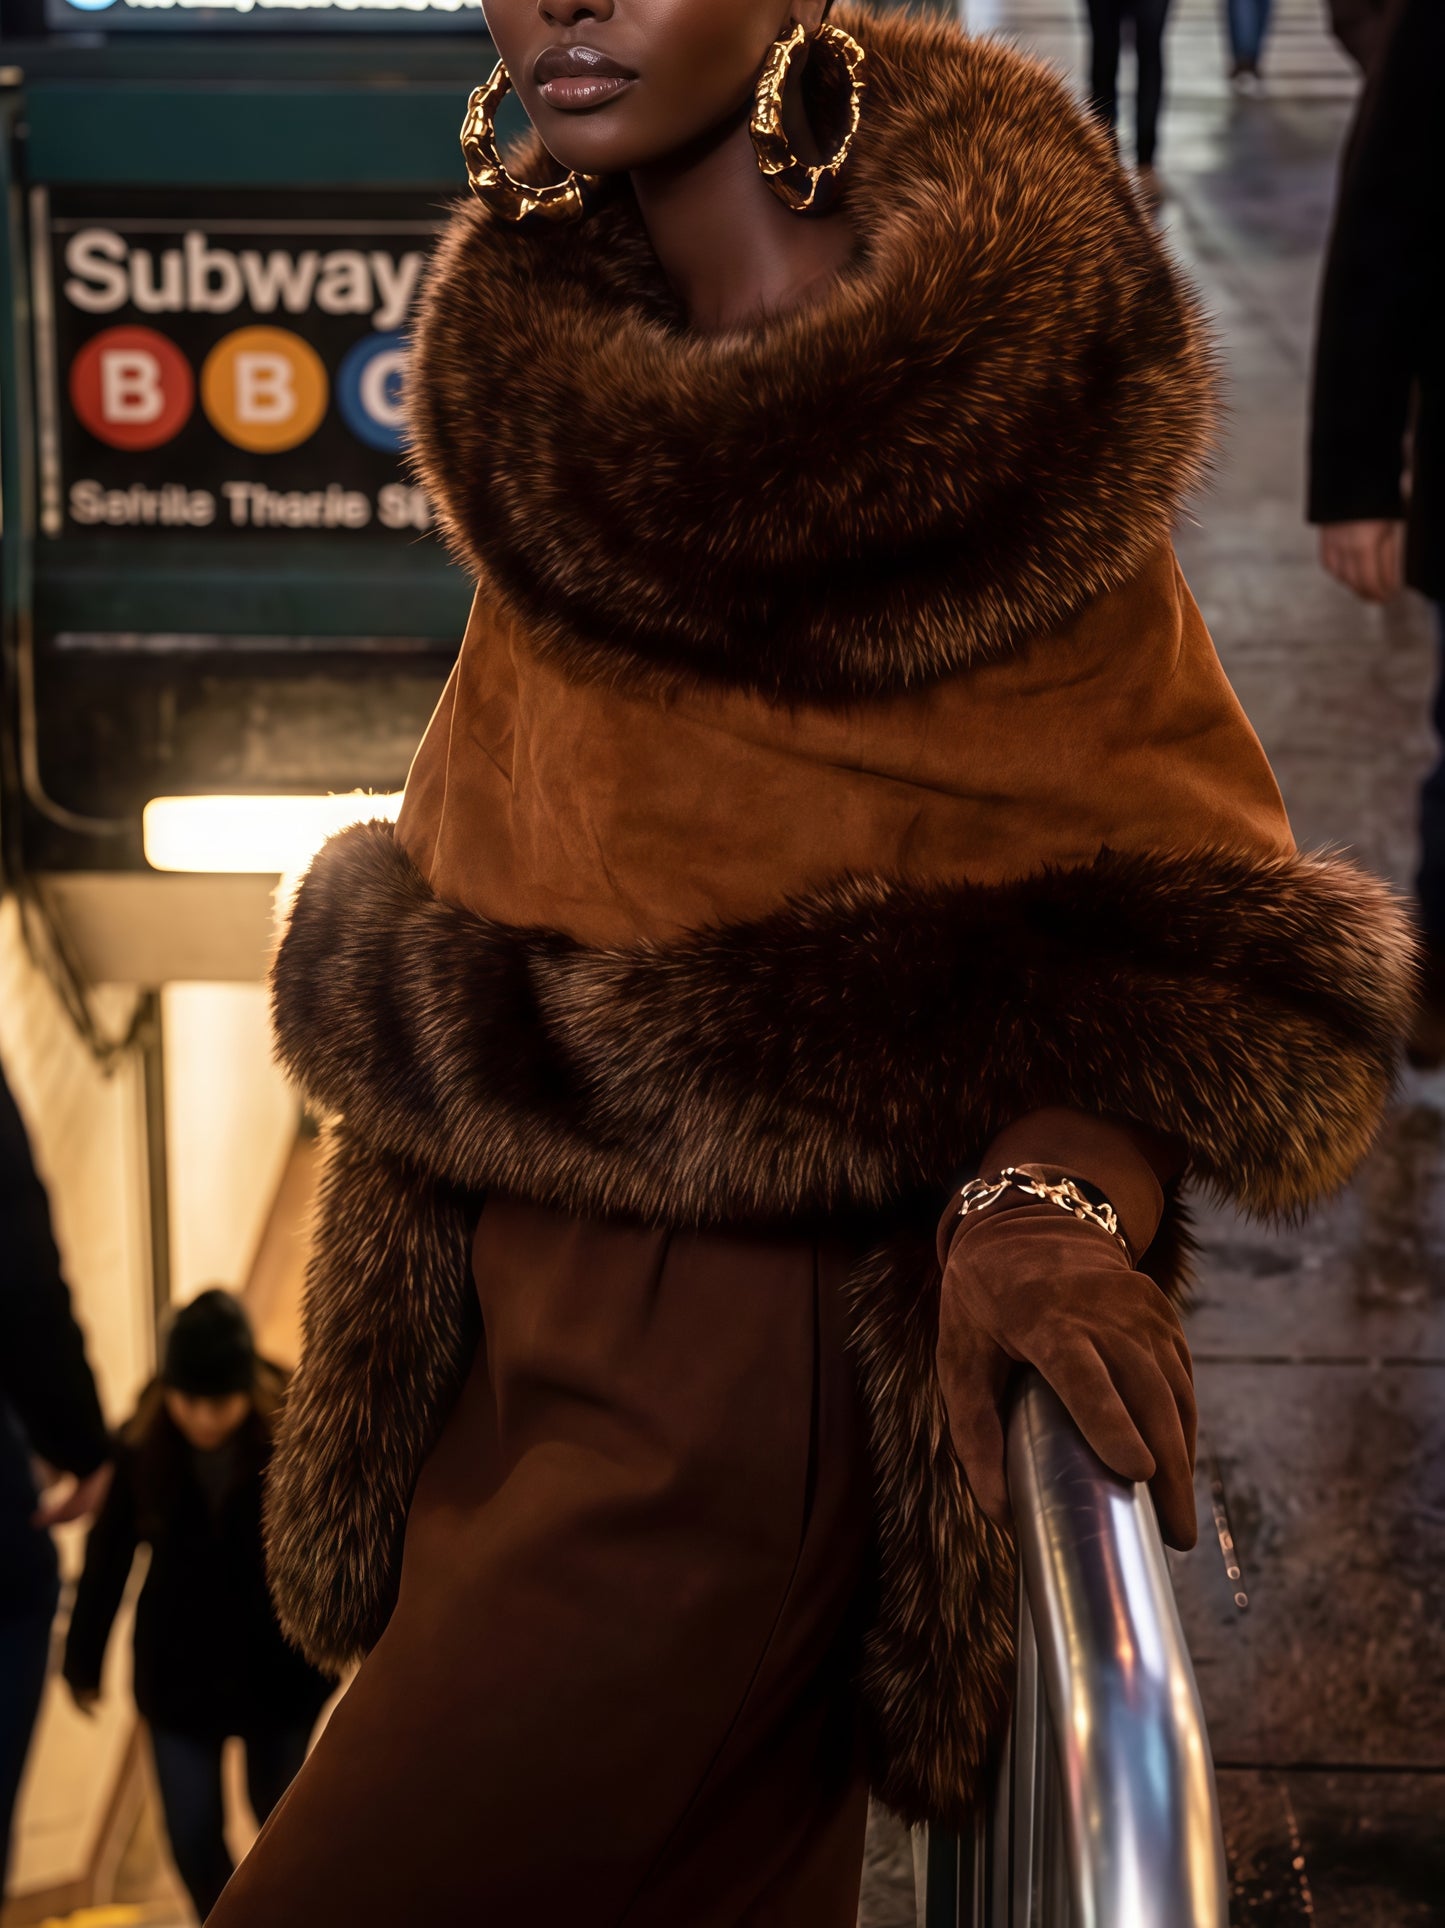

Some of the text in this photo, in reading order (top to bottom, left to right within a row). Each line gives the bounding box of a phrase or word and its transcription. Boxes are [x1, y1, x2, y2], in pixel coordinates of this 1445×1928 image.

[65, 229, 423, 331] Subway
[101, 348, 165, 423] B
[233, 351, 297, 424] B
